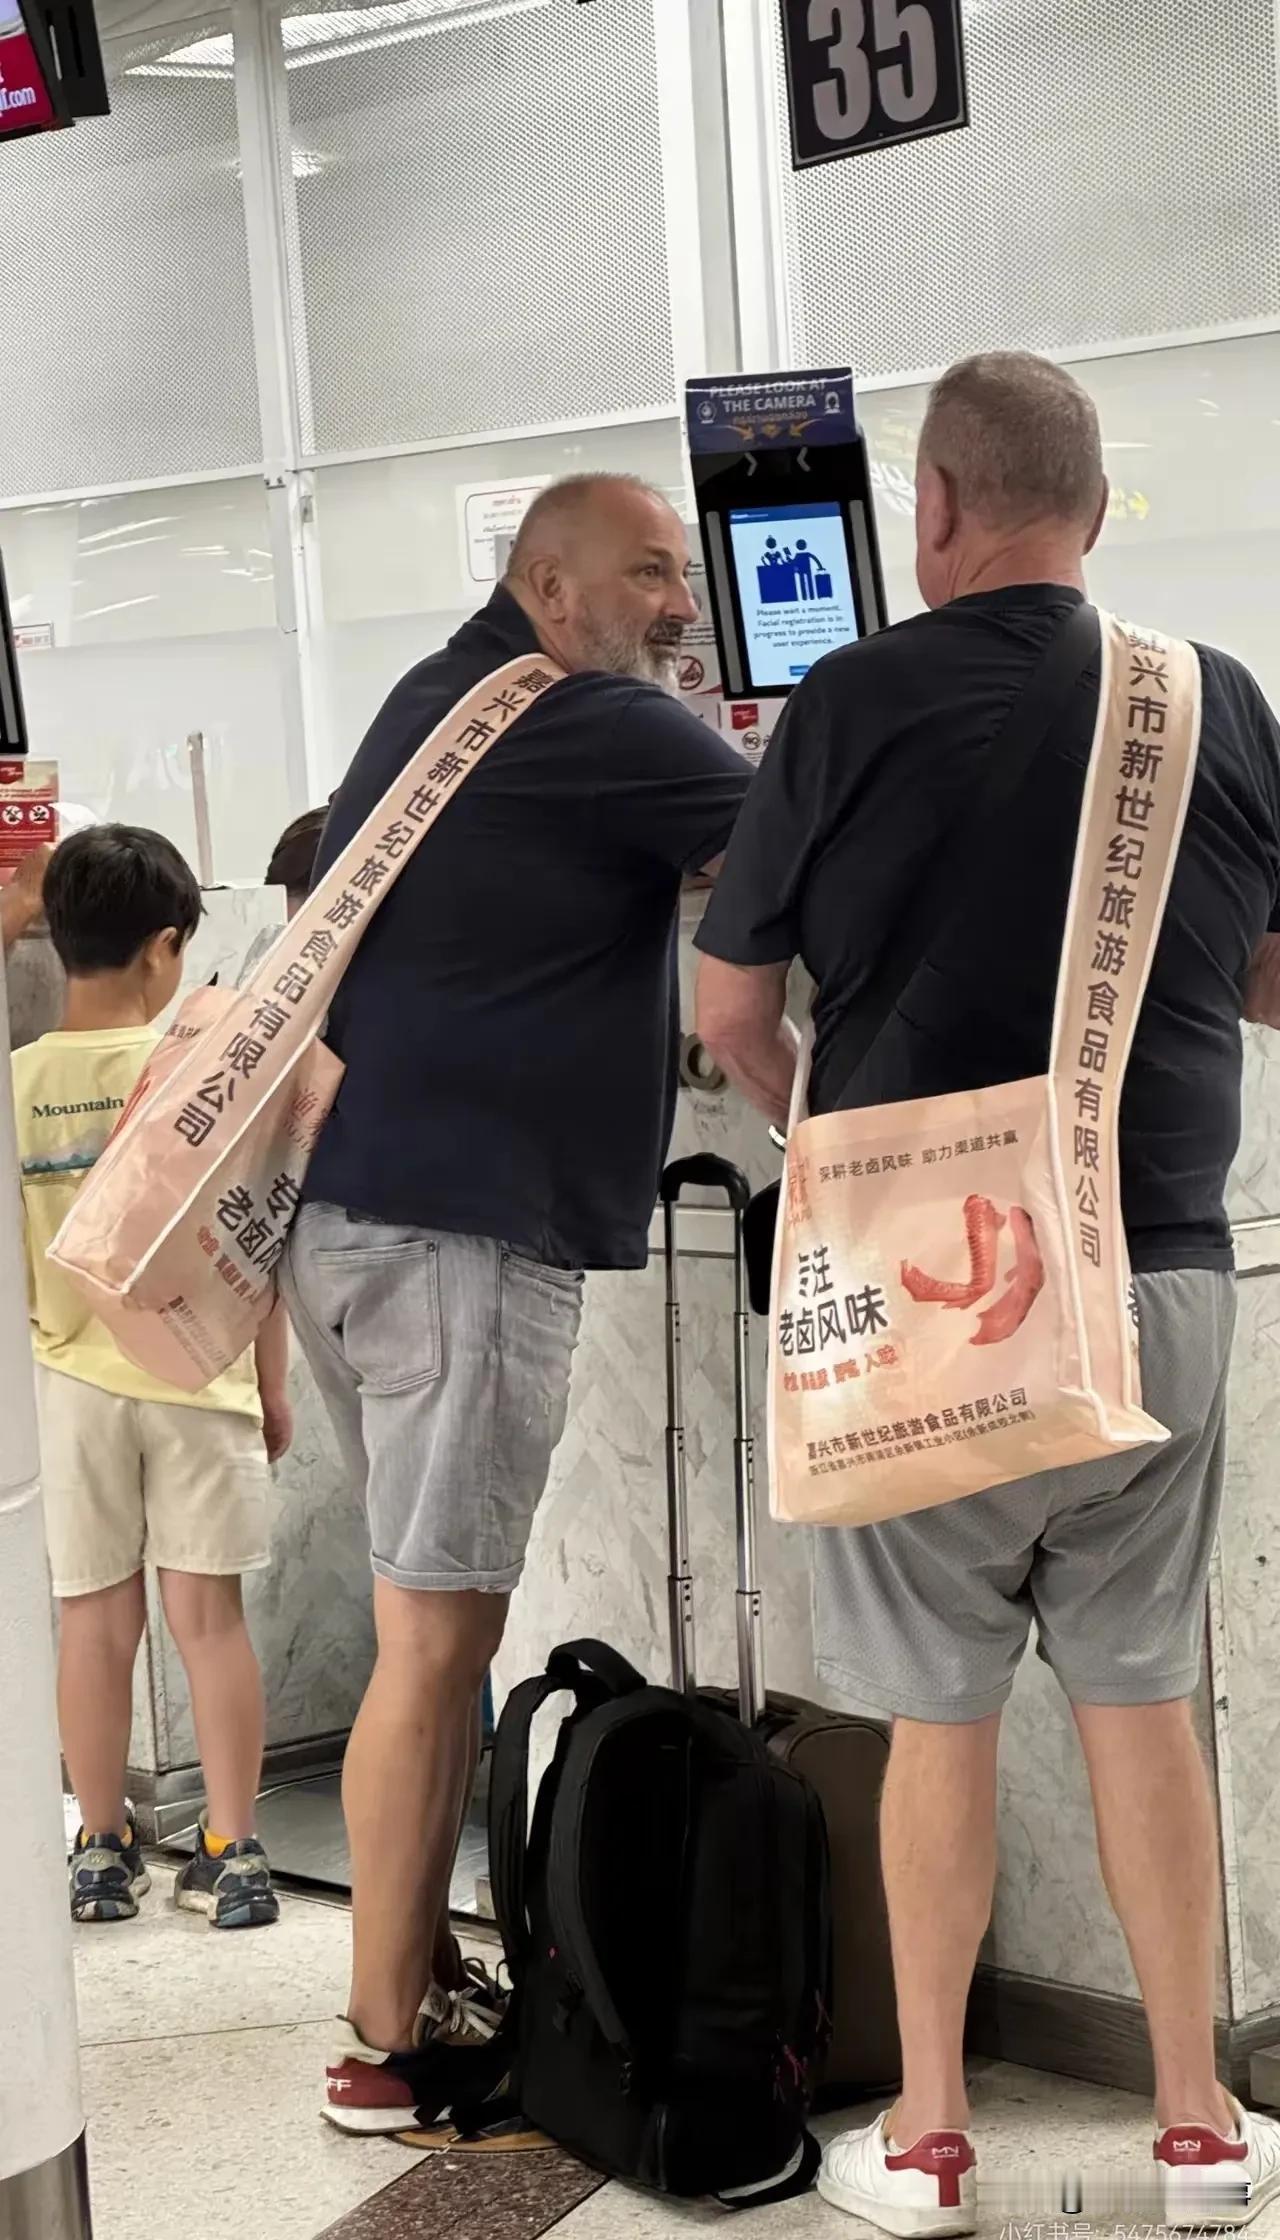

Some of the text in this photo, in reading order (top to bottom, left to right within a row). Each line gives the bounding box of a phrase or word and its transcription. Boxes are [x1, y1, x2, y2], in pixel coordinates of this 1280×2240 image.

[807, 0, 937, 140] 35
[709, 377, 826, 399] PLEASE LOOK AT
[723, 394, 816, 413] THE CAMERA
[756, 608, 781, 616] Please
[783, 607, 800, 615] wait
[757, 618, 780, 627] Facial
[782, 617, 826, 626] registration
[753, 630, 787, 640] progress
[798, 627, 826, 637] provide
[772, 640, 789, 648] user
[174, 668, 554, 1147] 嘉兴市新世纪旅游食品有限公司
[32, 1096, 124, 1119] Mountain
[779, 1284, 889, 1356] 老卤风味
[806, 1387, 1028, 1460] 嘉兴市新世纪旅游食品有限公司
